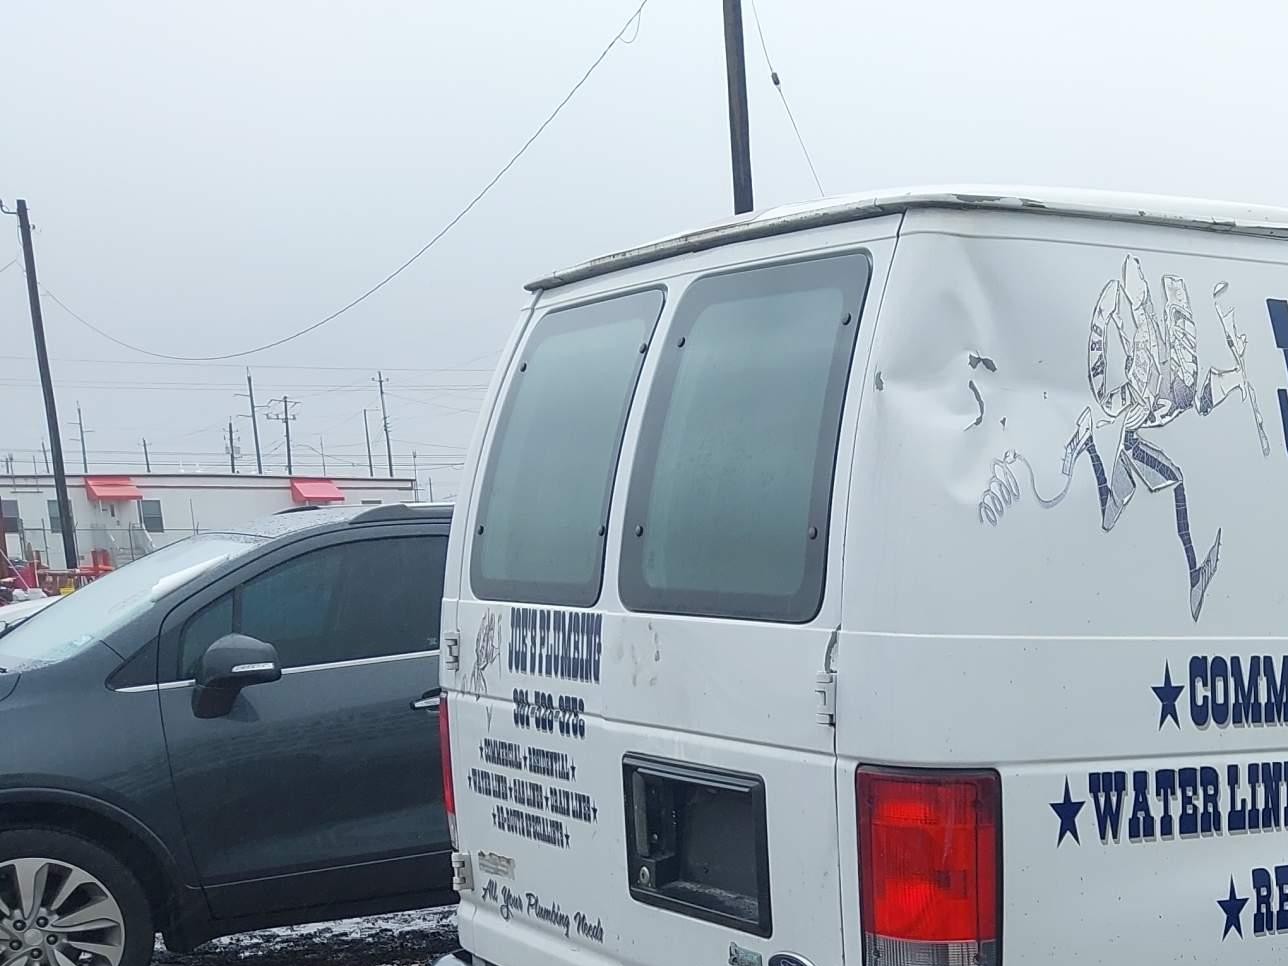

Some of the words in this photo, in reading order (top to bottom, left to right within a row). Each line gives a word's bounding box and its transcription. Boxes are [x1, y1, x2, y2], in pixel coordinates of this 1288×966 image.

[538, 609, 602, 685] PLUMBING
[1088, 764, 1222, 844] WATER
[482, 878, 498, 902] All
[500, 885, 523, 922] Your
[526, 892, 570, 938] Plumbing
[573, 912, 604, 944] Needs
